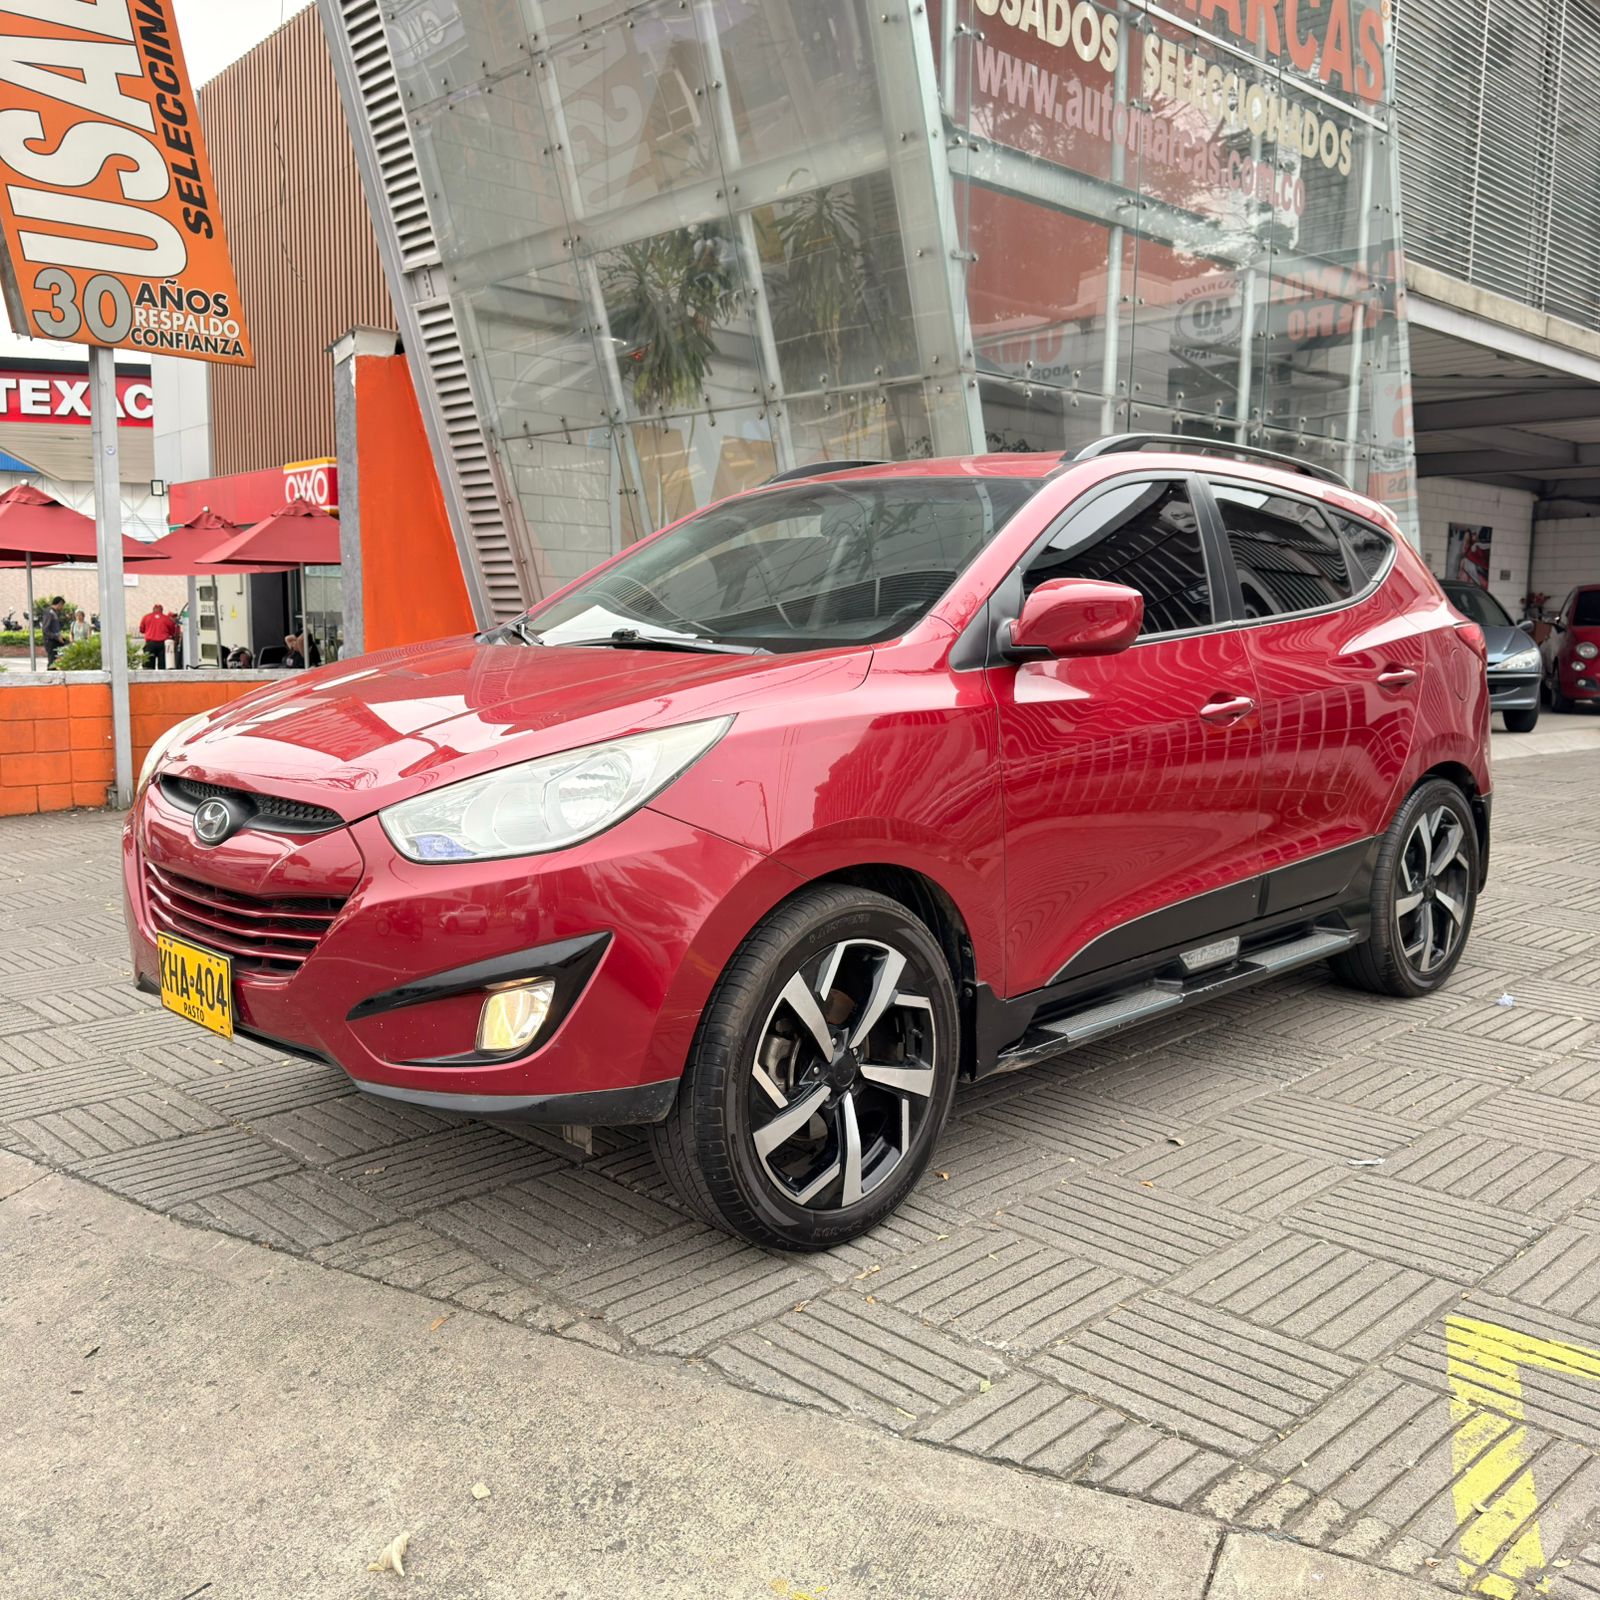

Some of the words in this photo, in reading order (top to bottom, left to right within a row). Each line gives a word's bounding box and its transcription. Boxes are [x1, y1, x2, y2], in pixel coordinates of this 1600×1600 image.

[975, 0, 1120, 73] ADOS
[976, 42, 1306, 216] www.automarcas.com.co
[1143, 33, 1353, 176] SELECCIONADOS
[32, 267, 133, 344] 30
[134, 279, 230, 318] AÑOS
[134, 307, 240, 339] RESPALDO
[130, 327, 245, 357] CONFIANZA
[285, 467, 328, 505] OXXO
[183, 1002, 205, 1022] PASTO
